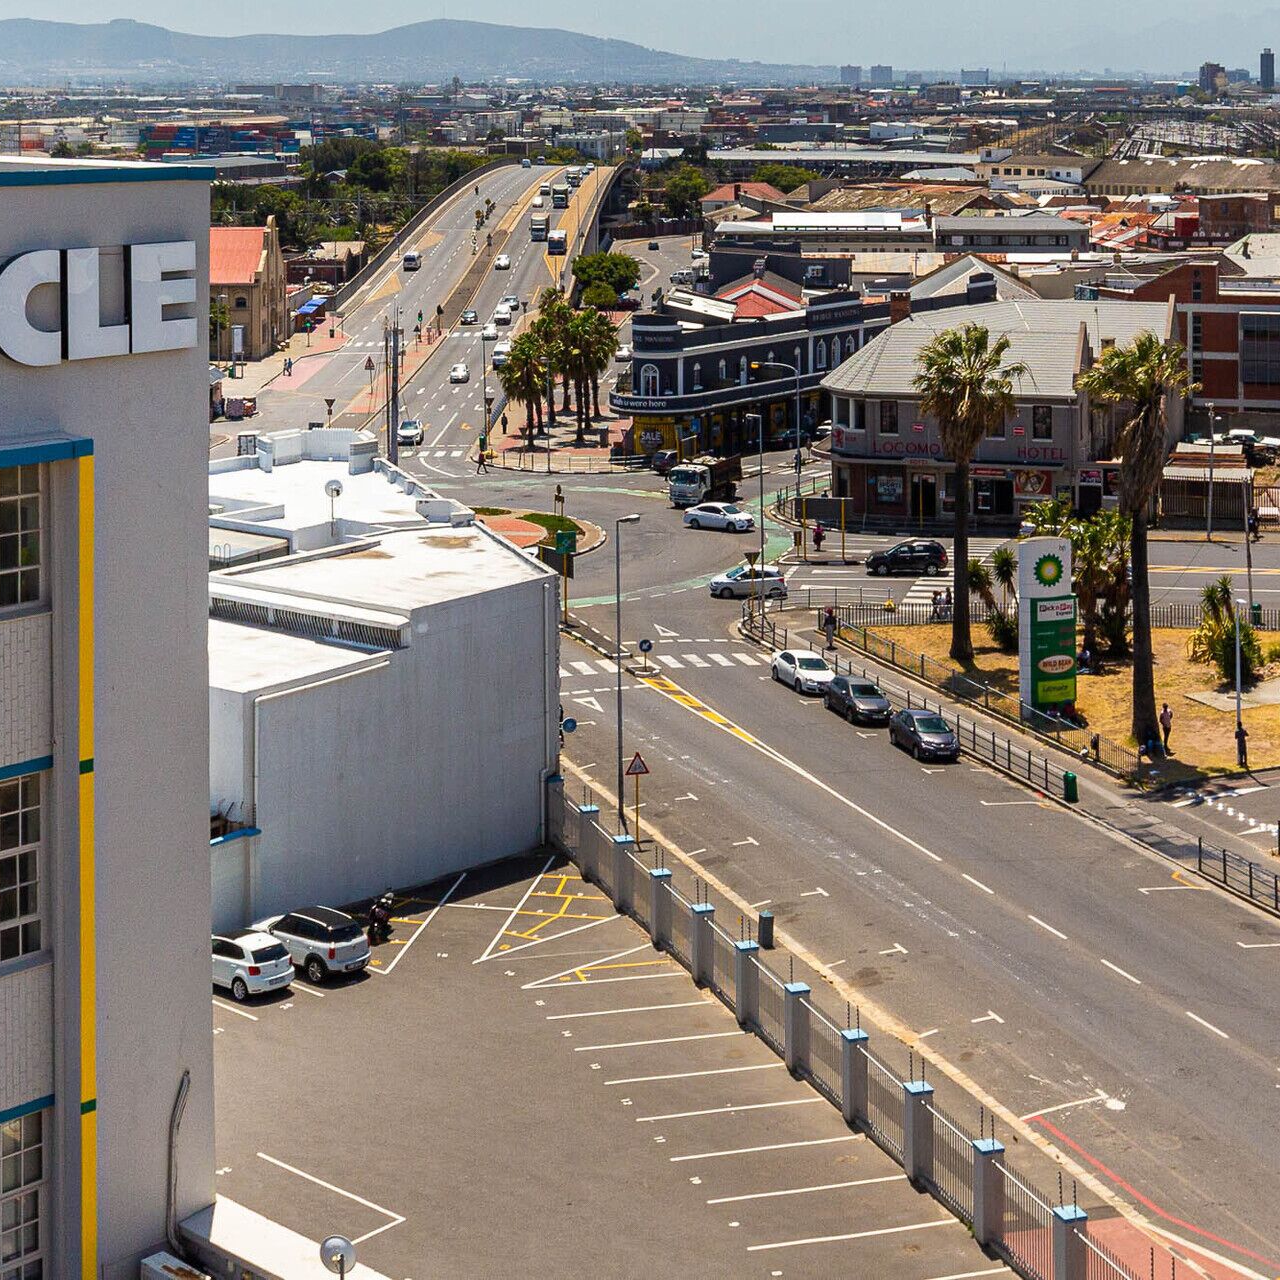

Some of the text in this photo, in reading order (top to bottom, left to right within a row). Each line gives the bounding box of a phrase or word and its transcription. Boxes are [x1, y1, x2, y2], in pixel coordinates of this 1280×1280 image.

[641, 431, 662, 441] SALE
[872, 441, 1068, 461] LOCOMO HOTEL
